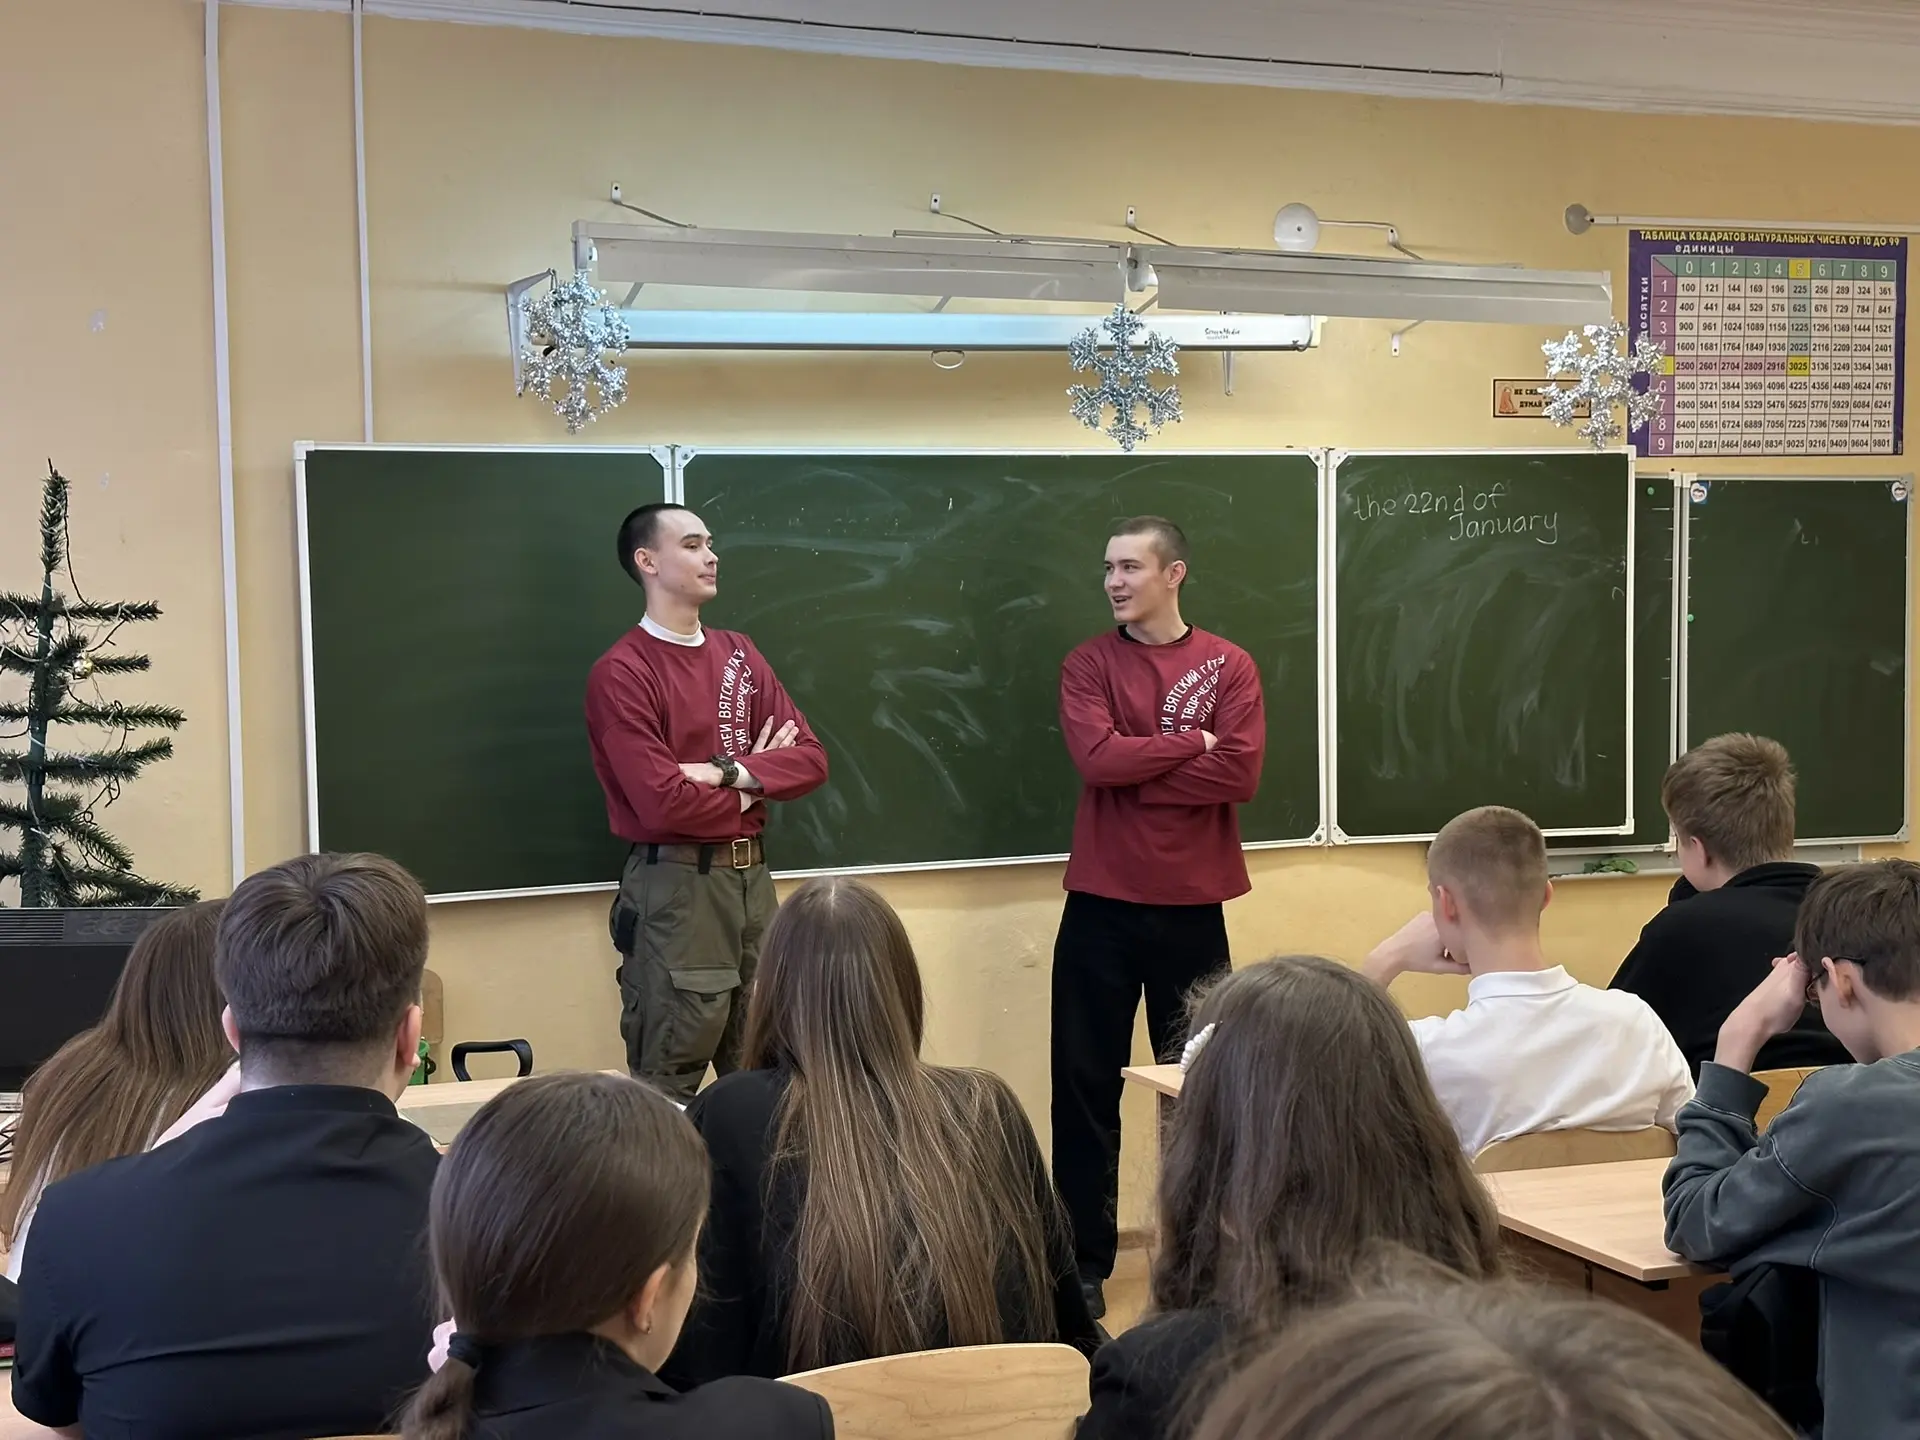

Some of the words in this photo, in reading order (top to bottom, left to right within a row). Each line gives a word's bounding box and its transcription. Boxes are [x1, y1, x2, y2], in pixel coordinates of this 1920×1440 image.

[1640, 231, 1686, 242] ТАБЛИЦА
[1689, 232, 1746, 242] КВАДРАТОВ
[1748, 233, 1814, 244] НАТУРАЛЬНЫХ
[1816, 236, 1846, 244] ЧИСЕЛ
[1849, 236, 1860, 245] ОТ
[1863, 237, 1871, 245] 10
[1873, 237, 1886, 247] ДО
[1889, 237, 1900, 246] 99
[1675, 244, 1734, 254] единицы
[1686, 261, 1693, 274] 0
[1732, 262, 1739, 274] 2
[1754, 262, 1760, 275] 3
[1775, 264, 1782, 275] 4
[1796, 264, 1804, 276] 5
[1818, 264, 1826, 276] 6
[1840, 264, 1846, 277] 7
[1861, 265, 1867, 277] 8
[1881, 266, 1888, 278] 9
[1661, 280, 1667, 292] 1
[1681, 283, 1696, 292] 100
[1705, 283, 1719, 292] 121
[1728, 284, 1741, 292] 144
[1750, 284, 1763, 293] 169
[1771, 284, 1785, 294] 196
[1793, 285, 1808, 294] 225
[1815, 285, 1829, 295] 256
[1836, 285, 1850, 295] 289
[1857, 286, 1871, 295] 324
[1878, 286, 1891, 296] 361
[1660, 300, 1667, 312] 2
[1679, 302, 1695, 311] 400
[1703, 303, 1718, 311] 441
[1726, 303, 1741, 312] 484
[1749, 303, 1763, 312] 529
[1771, 303, 1785, 312] 576
[1792, 304, 1807, 313] 625
[1814, 304, 1828, 313] 676
[1835, 304, 1849, 313] 729
[1856, 304, 1870, 314] 784
[1878, 305, 1891, 314] 841
[1660, 321, 1667, 334] 3
[1679, 322, 1694, 331] 900
[1702, 322, 1717, 331] 961
[1724, 322, 1742, 331] 1024
[1746, 322, 1765, 331] 1089
[1769, 322, 1787, 332] 1156
[1791, 323, 1809, 332] 1225
[1813, 323, 1830, 332] 1296
[1833, 323, 1850, 332] 1369
[1854, 324, 1871, 332] 1444
[1875, 324, 1892, 333] 1521
[1659, 340, 1666, 352] 4
[1677, 342, 1695, 351] 1600
[1700, 342, 1718, 351] 1681
[1723, 342, 1741, 351] 1764
[1745, 342, 1764, 352] 1849
[1768, 342, 1786, 352] 1936
[1790, 343, 1808, 352] 2025
[1812, 343, 1830, 352] 2116
[1833, 343, 1850, 352] 2209
[1853, 343, 1871, 352] 2304
[1875, 344, 1892, 352] 2401
[1676, 361, 1695, 370] 2500
[1699, 361, 1717, 371] 2601
[1721, 362, 1740, 371] 2704
[1744, 362, 1763, 371] 2809
[1766, 362, 1786, 371] 2916
[1788, 362, 1808, 371] 3025
[1811, 362, 1829, 371] 3136
[1832, 362, 1850, 371] 3249
[1853, 362, 1871, 371] 3364
[1875, 362, 1892, 371] 3481
[1659, 380, 1666, 392] 6
[1676, 381, 1696, 390] 3600
[1699, 381, 1718, 390] 3721
[1722, 381, 1740, 390] 3844
[1744, 381, 1763, 390] 3969
[1766, 381, 1786, 390] 4096
[1788, 381, 1808, 390] 4225
[1811, 381, 1829, 390] 4356
[1832, 382, 1850, 390] 4489
[1853, 382, 1871, 390] 4624
[1875, 382, 1892, 391] 4761
[1659, 399, 1666, 411] 7
[1676, 400, 1696, 409] 4900
[1699, 400, 1717, 409] 5041
[1721, 400, 1740, 409] 5184
[1744, 400, 1763, 409] 5329
[1766, 400, 1785, 409] 5476
[1788, 400, 1807, 409] 5625
[1810, 400, 1828, 409] 5776
[1832, 400, 1850, 409] 5929
[1852, 400, 1870, 409] 6084
[1874, 400, 1891, 409] 6241
[1659, 418, 1666, 431] 8
[1676, 420, 1696, 429] 6400
[1699, 420, 1718, 429] 6561
[1722, 420, 1740, 429] 6724
[1744, 420, 1763, 429] 6889
[1766, 420, 1785, 429] 7056
[1788, 420, 1806, 428] 7225
[1810, 419, 1827, 428] 7396
[1831, 419, 1848, 428] 7569
[1852, 419, 1870, 428] 7744
[1873, 419, 1890, 428] 7921
[1658, 438, 1665, 451] 9
[1675, 440, 1694, 449] 8100
[1698, 440, 1717, 449] 8281
[1720, 440, 1739, 449] 8464
[1742, 440, 1761, 448] 8649
[1786, 439, 1805, 448] 9025
[1808, 439, 1826, 448] 9216
[1829, 439, 1848, 448] 9409
[1850, 439, 1869, 448] 9604
[1872, 438, 1890, 448] 9801
[1354, 494, 1398, 522] the
[1404, 485, 1465, 514] 22nd
[1472, 482, 1507, 511] of
[1448, 511, 1558, 545] January
[718, 666, 737, 718] ВЯТСКИЙ
[1163, 669, 1202, 713] ВЯТСКИЙ
[1161, 716, 1175, 736] ЕИ
